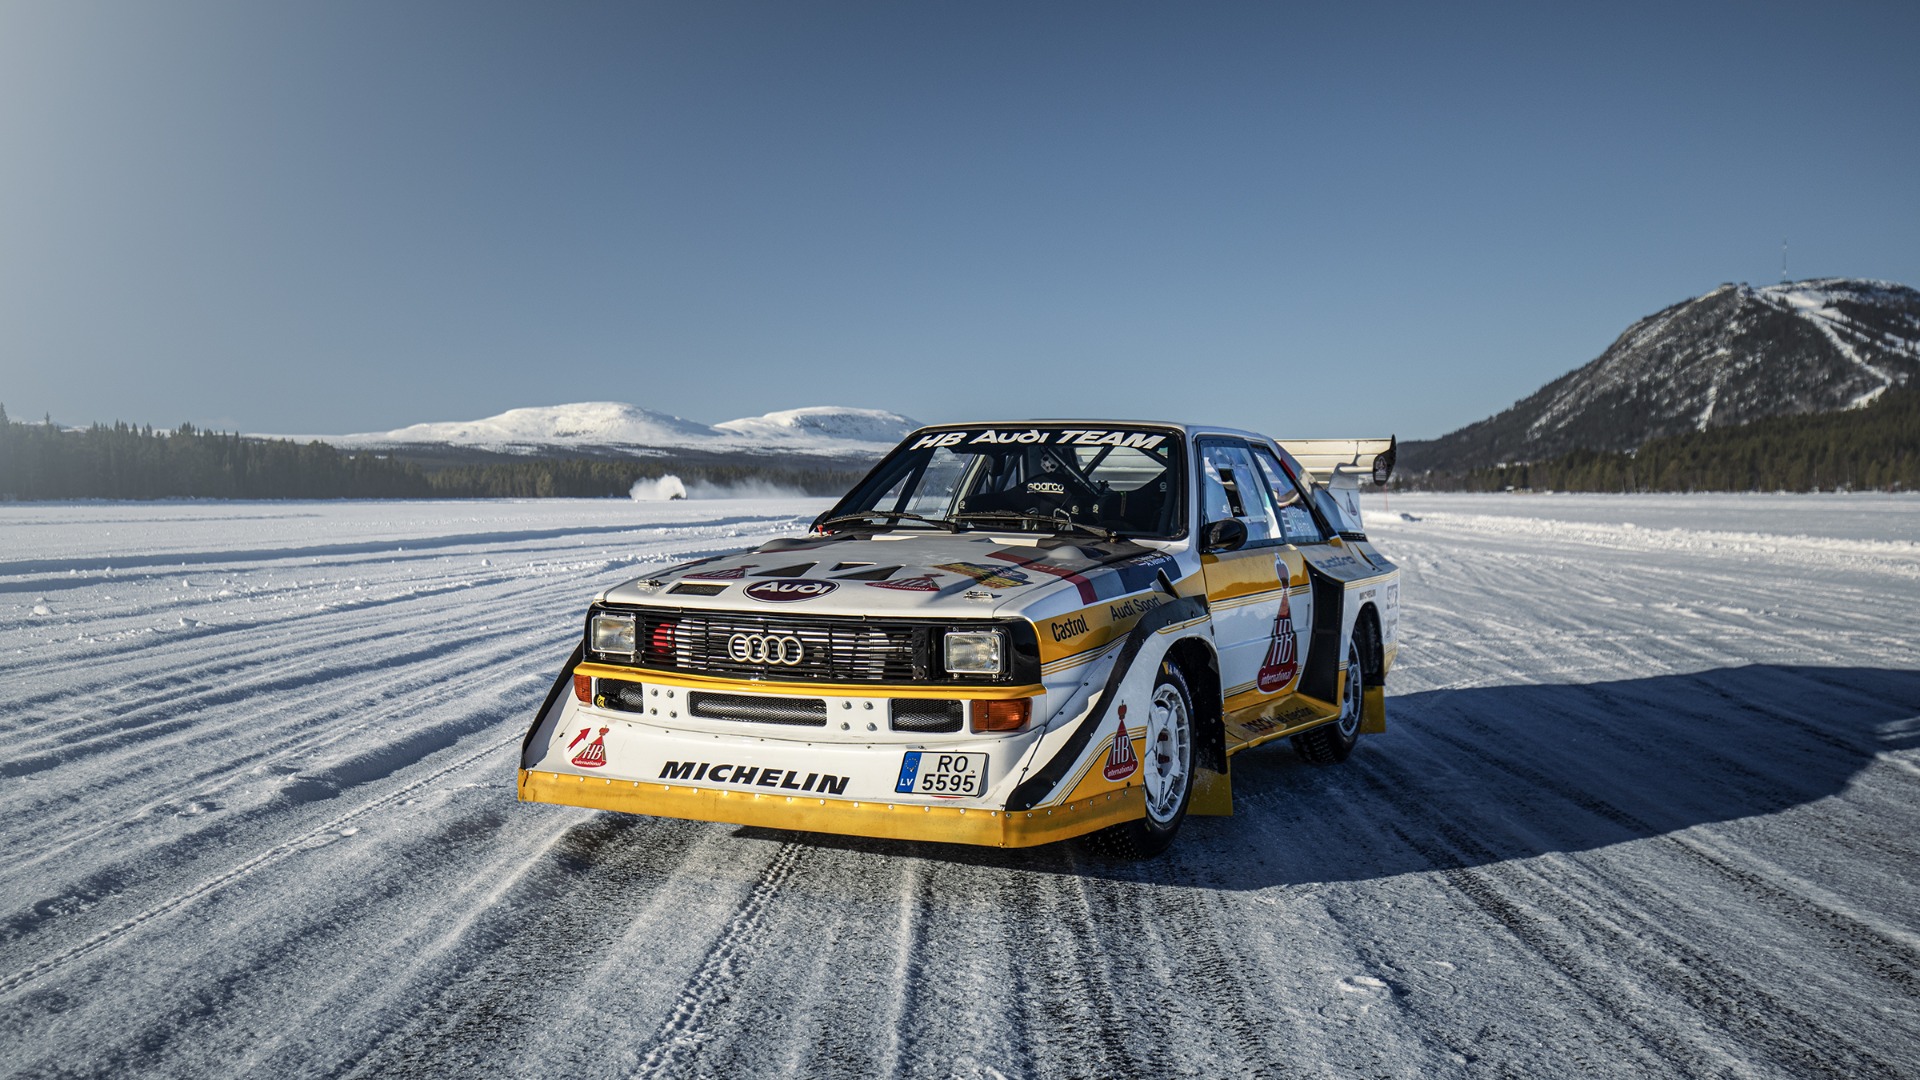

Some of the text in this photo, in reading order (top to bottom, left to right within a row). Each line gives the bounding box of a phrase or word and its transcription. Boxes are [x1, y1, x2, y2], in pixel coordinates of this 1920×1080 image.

[910, 429, 1168, 451] HB Audi TEAM
[1027, 482, 1064, 492] sparco
[757, 580, 830, 597] Audi
[1110, 595, 1162, 622] Audi Sport
[1052, 614, 1090, 643] Castrol
[1271, 618, 1294, 666] HB
[1261, 668, 1293, 686] international
[583, 743, 603, 761] HB
[1113, 735, 1130, 765] HB
[573, 757, 602, 768] international
[936, 754, 970, 772] RO
[1107, 764, 1135, 777] international
[658, 761, 851, 796] MICHELIN
[899, 777, 913, 787] LV
[920, 773, 977, 794] 5595
